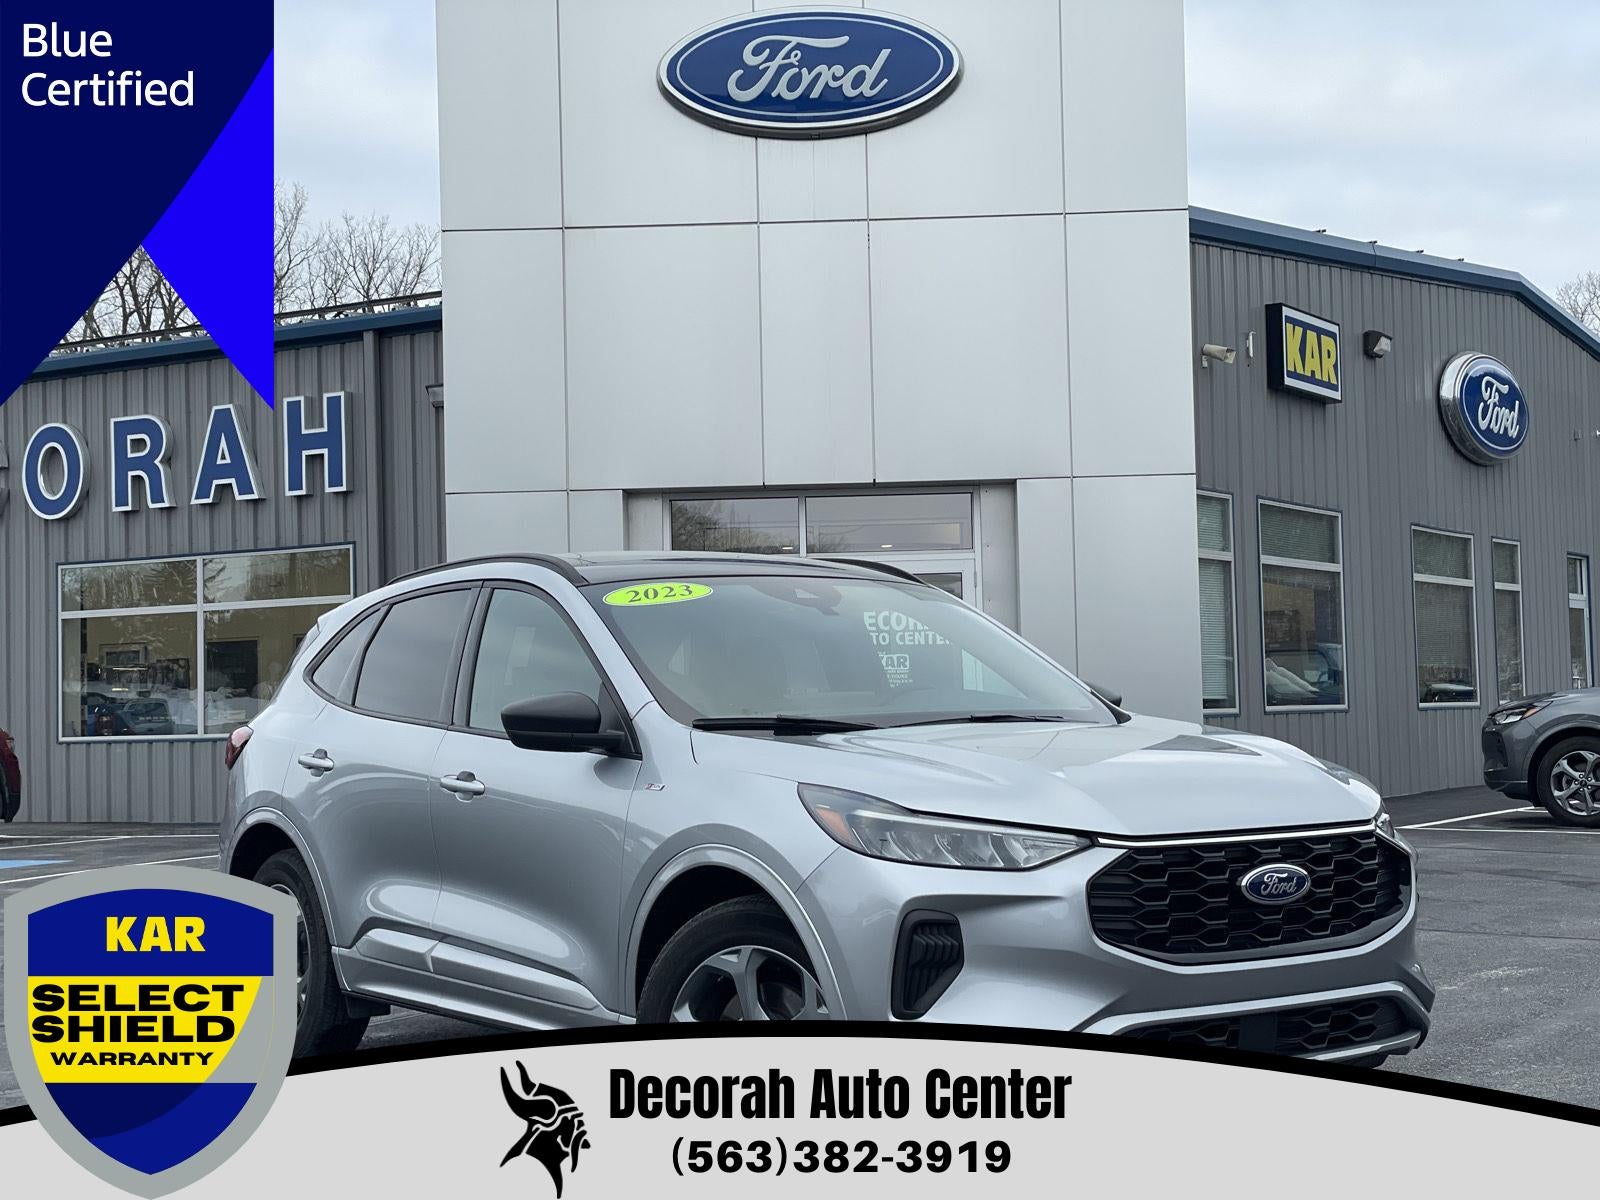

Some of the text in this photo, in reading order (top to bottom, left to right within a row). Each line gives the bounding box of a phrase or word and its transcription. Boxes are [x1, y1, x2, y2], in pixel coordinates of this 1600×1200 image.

[727, 34, 892, 102] Ford
[1285, 321, 1338, 385] KAR
[1477, 375, 1521, 439] Ford
[0, 390, 352, 521] ORAH
[625, 584, 693, 603] 2023
[895, 631, 950, 646] CENTE
[1260, 872, 1298, 896] Ford
